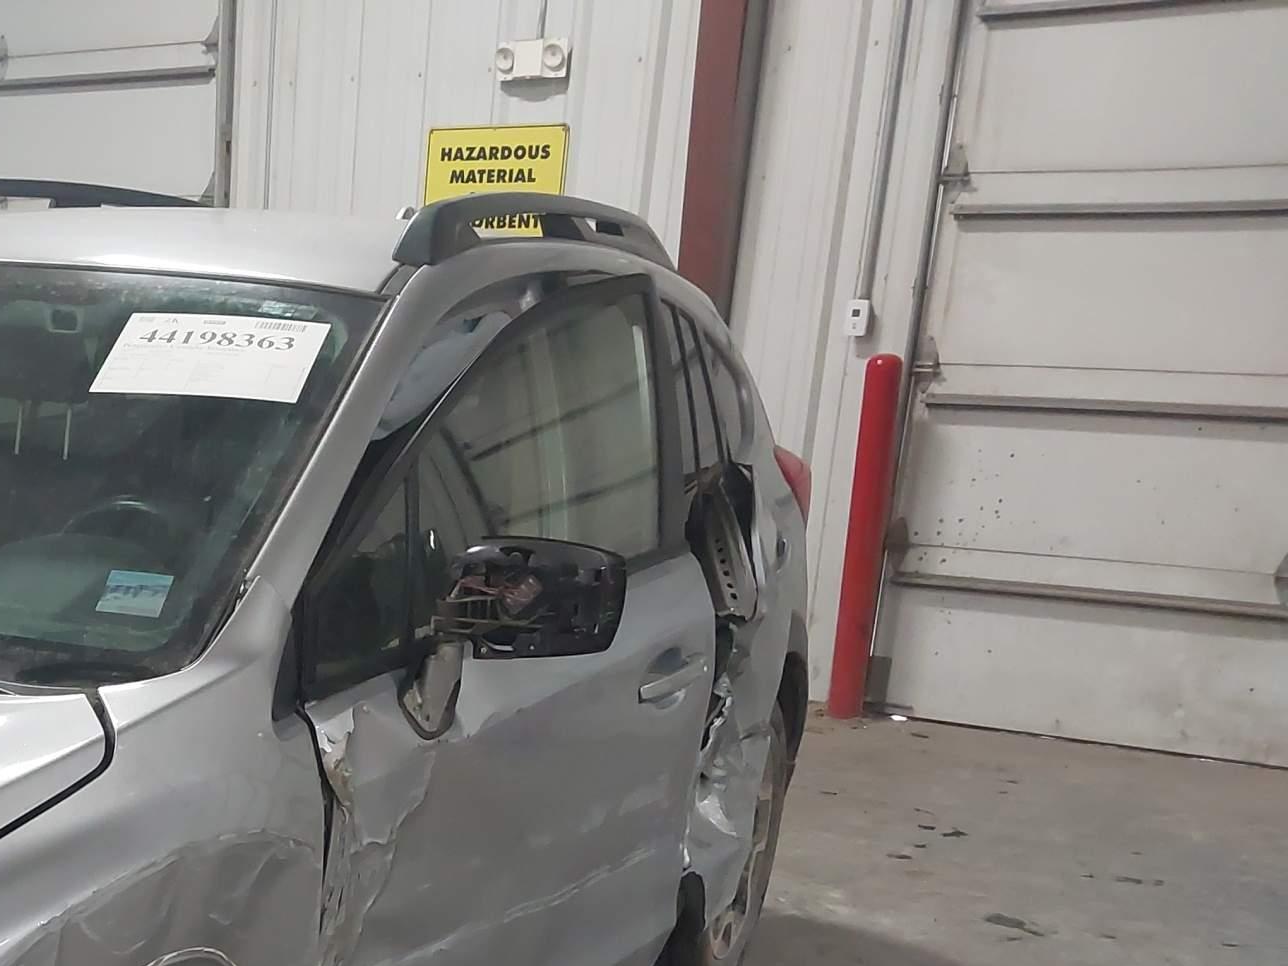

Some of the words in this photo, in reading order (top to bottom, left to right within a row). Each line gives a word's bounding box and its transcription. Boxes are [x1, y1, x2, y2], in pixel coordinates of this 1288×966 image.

[440, 144, 551, 162] HAZARDOUS
[449, 168, 537, 184] MATERIAL
[472, 213, 540, 229] ORBENT
[139, 328, 295, 351] 44198363
